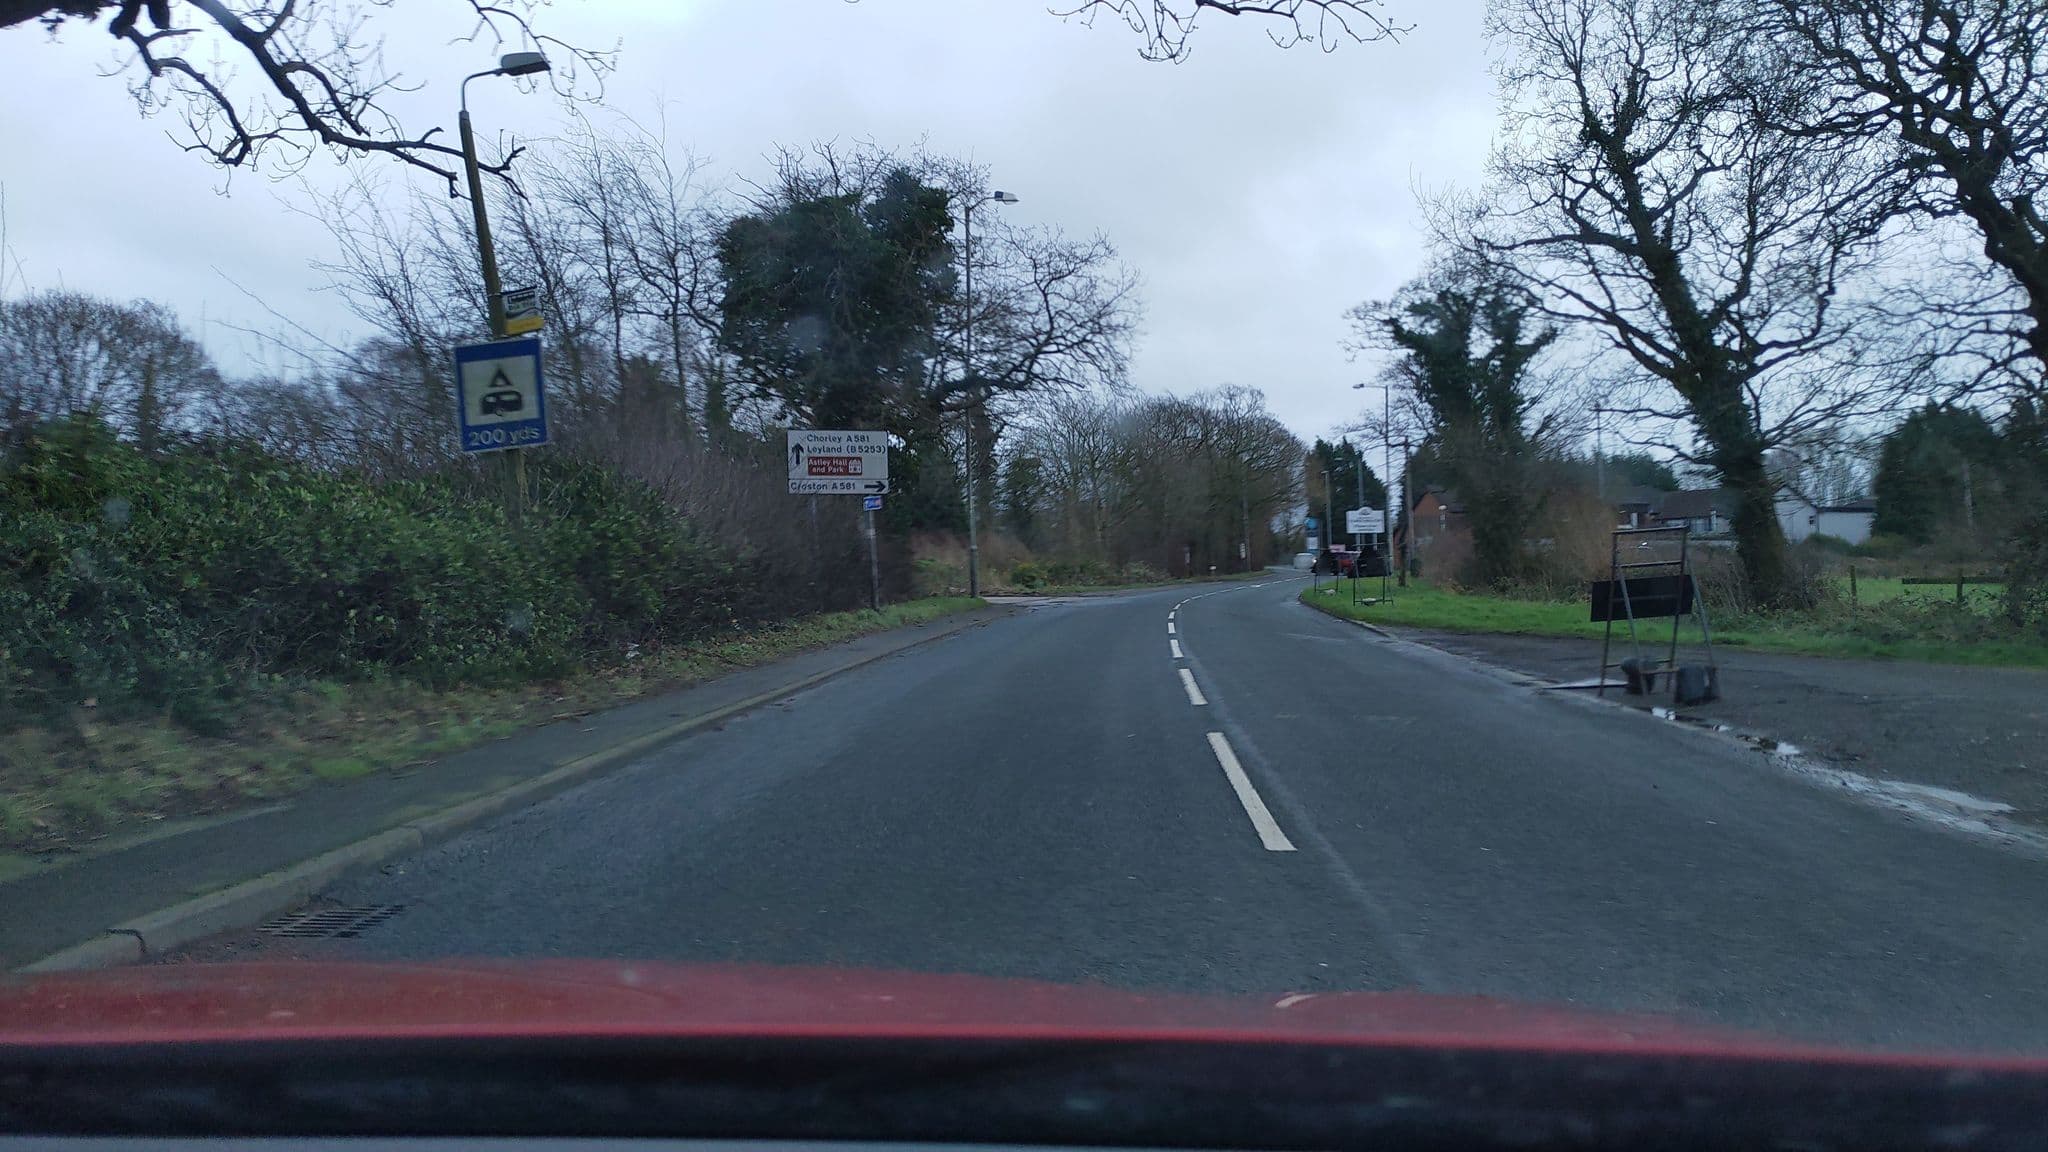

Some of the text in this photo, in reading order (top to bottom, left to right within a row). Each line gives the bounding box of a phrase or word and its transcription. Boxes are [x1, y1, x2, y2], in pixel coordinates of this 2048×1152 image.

[471, 426, 540, 446] 200 yds
[807, 434, 842, 443] Chorley
[807, 445, 842, 454] Leyland
[808, 458, 848, 466] Astley Hall
[790, 482, 828, 491] Croston
